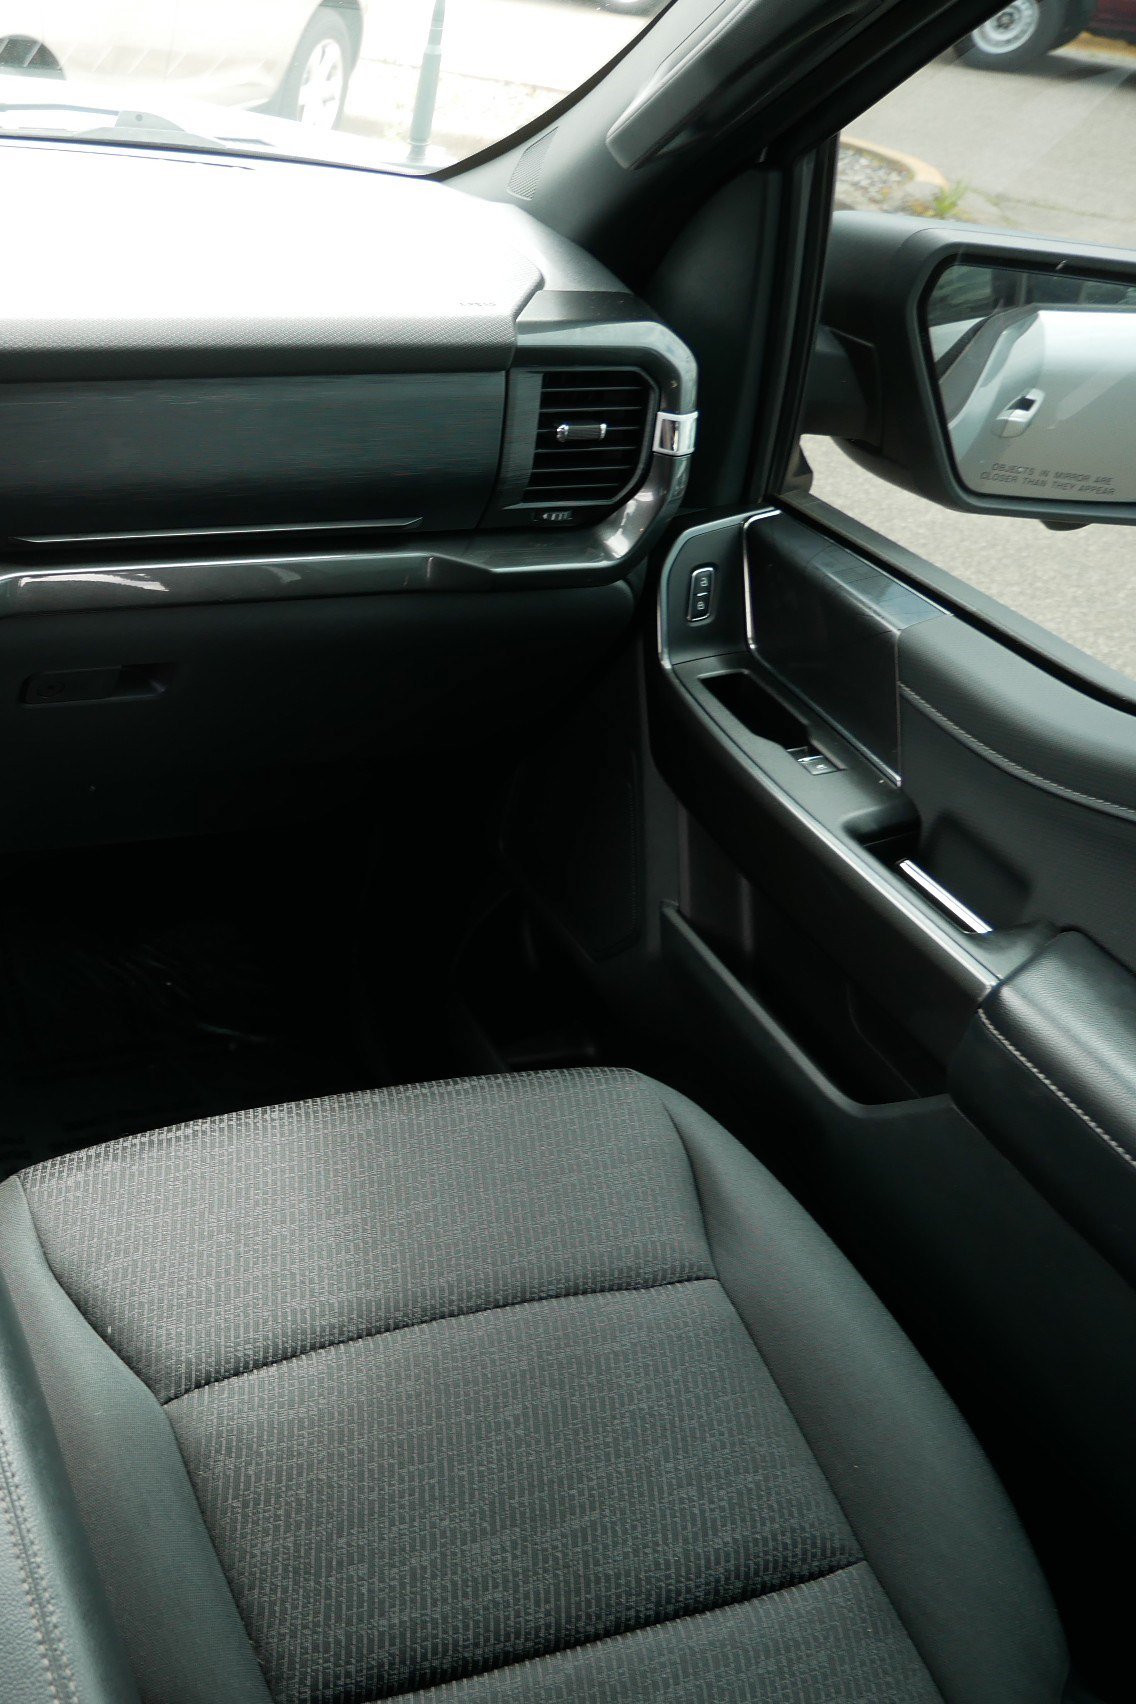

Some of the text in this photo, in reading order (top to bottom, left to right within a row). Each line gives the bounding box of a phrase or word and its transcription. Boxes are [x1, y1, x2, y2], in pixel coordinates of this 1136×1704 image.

[991, 463, 1036, 476] OBJECTS
[980, 471, 1018, 483] CLOSER
[1023, 477, 1047, 487] THAN
[1052, 481, 1076, 491] THEY
